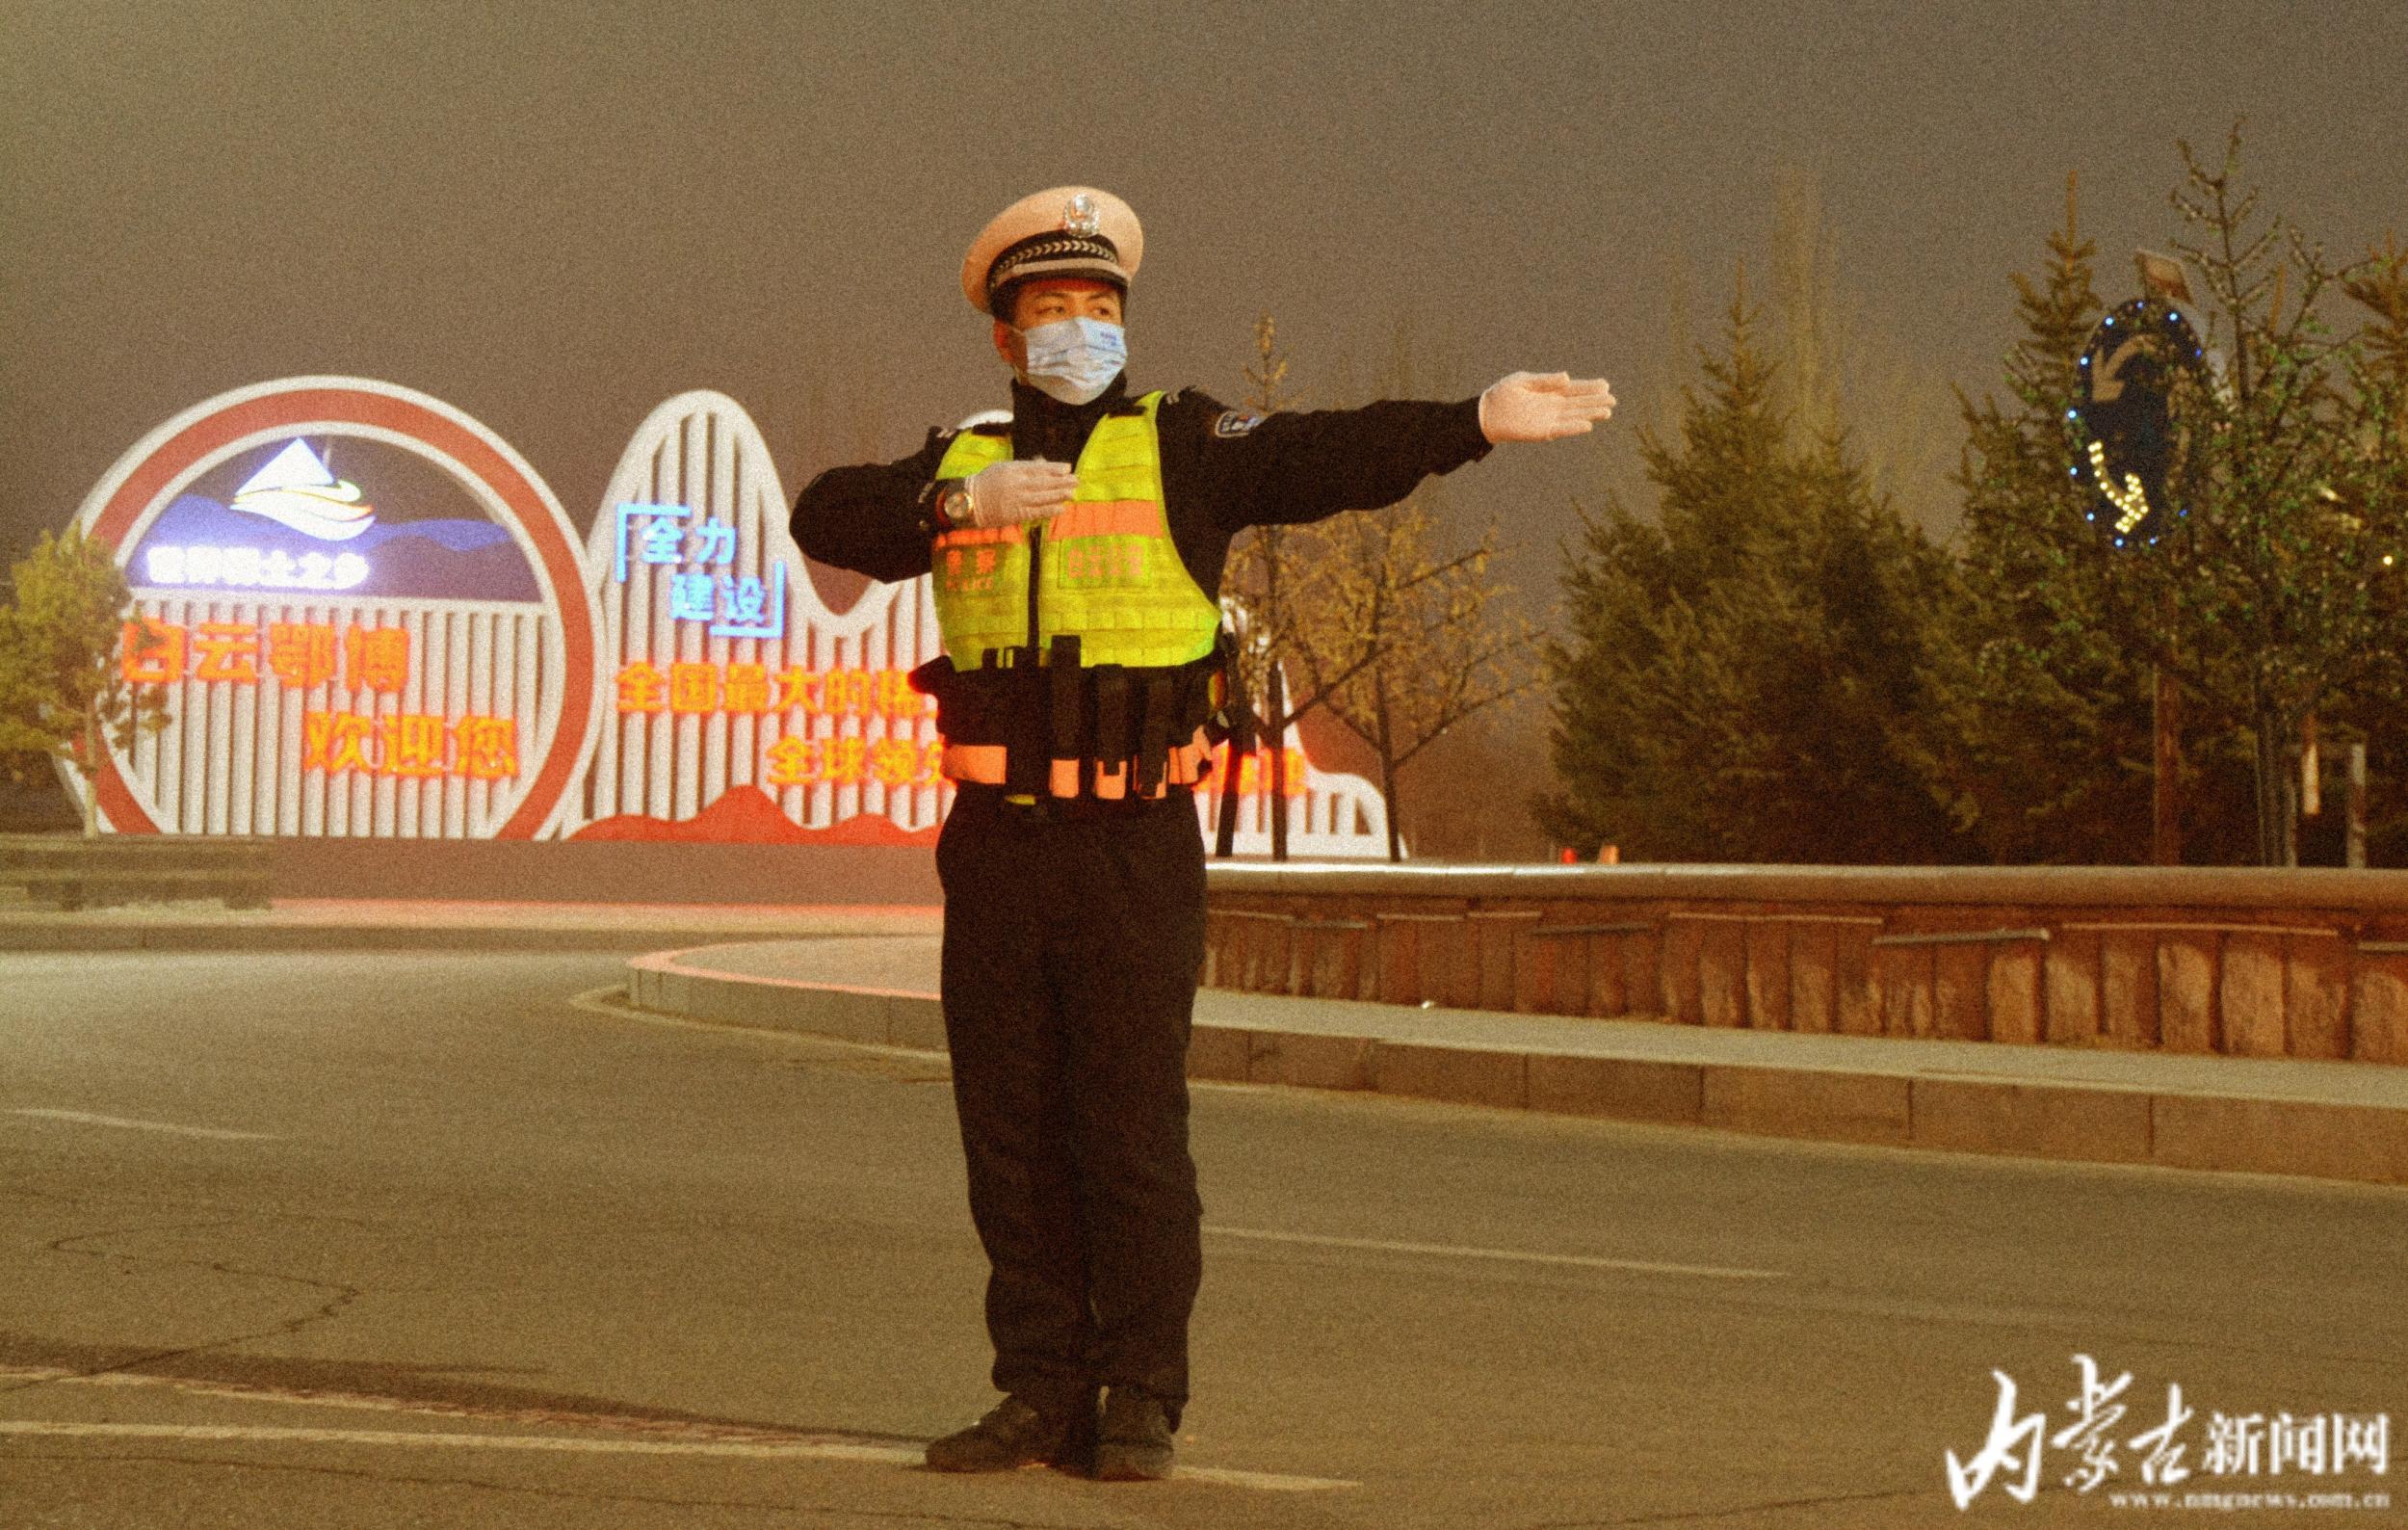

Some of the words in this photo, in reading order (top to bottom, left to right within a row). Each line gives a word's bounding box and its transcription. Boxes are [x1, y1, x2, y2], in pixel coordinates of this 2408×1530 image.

[639, 515, 737, 566] 全力
[669, 574, 766, 622] 建设
[122, 617, 411, 694] 白云鄂博
[302, 710, 520, 778] 欢迎您
